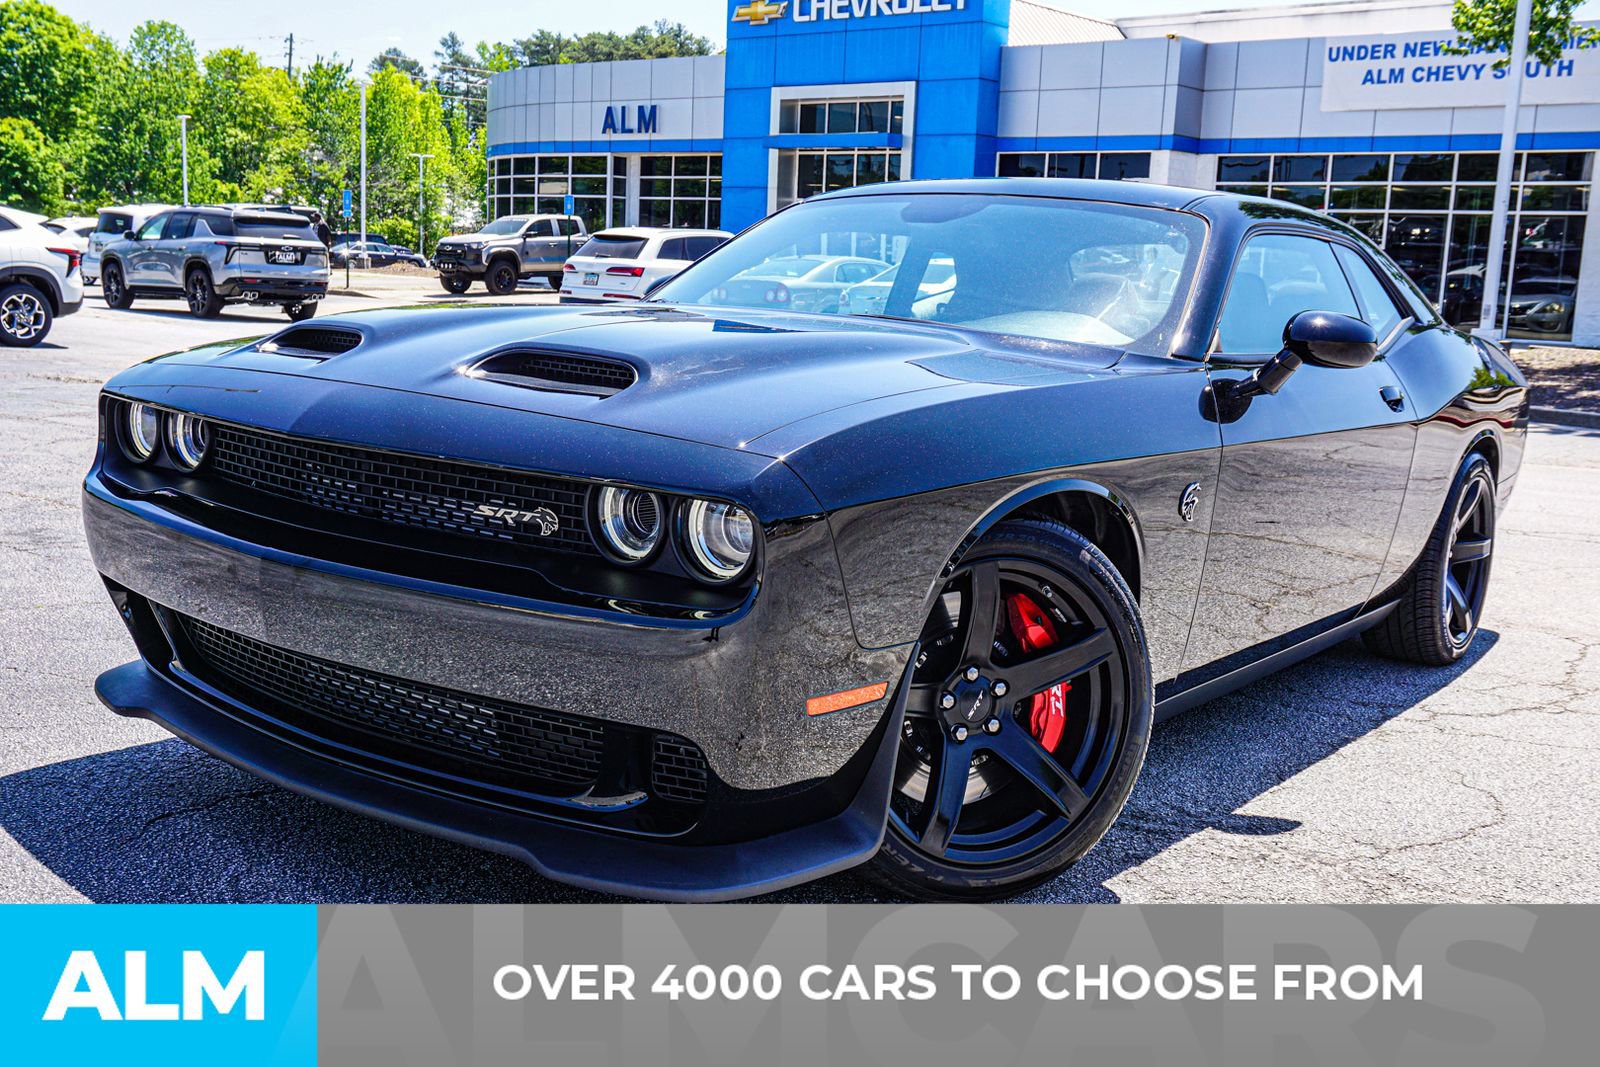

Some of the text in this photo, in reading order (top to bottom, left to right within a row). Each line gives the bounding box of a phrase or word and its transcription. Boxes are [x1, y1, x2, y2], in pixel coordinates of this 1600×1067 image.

[1328, 43, 1396, 62] UNDER
[1403, 40, 1452, 58] NEW
[1361, 60, 1574, 85] ALM CHEVY SUTH
[602, 105, 657, 134] ALM
[473, 504, 541, 526] SRT
[1051, 684, 1065, 718] RT
